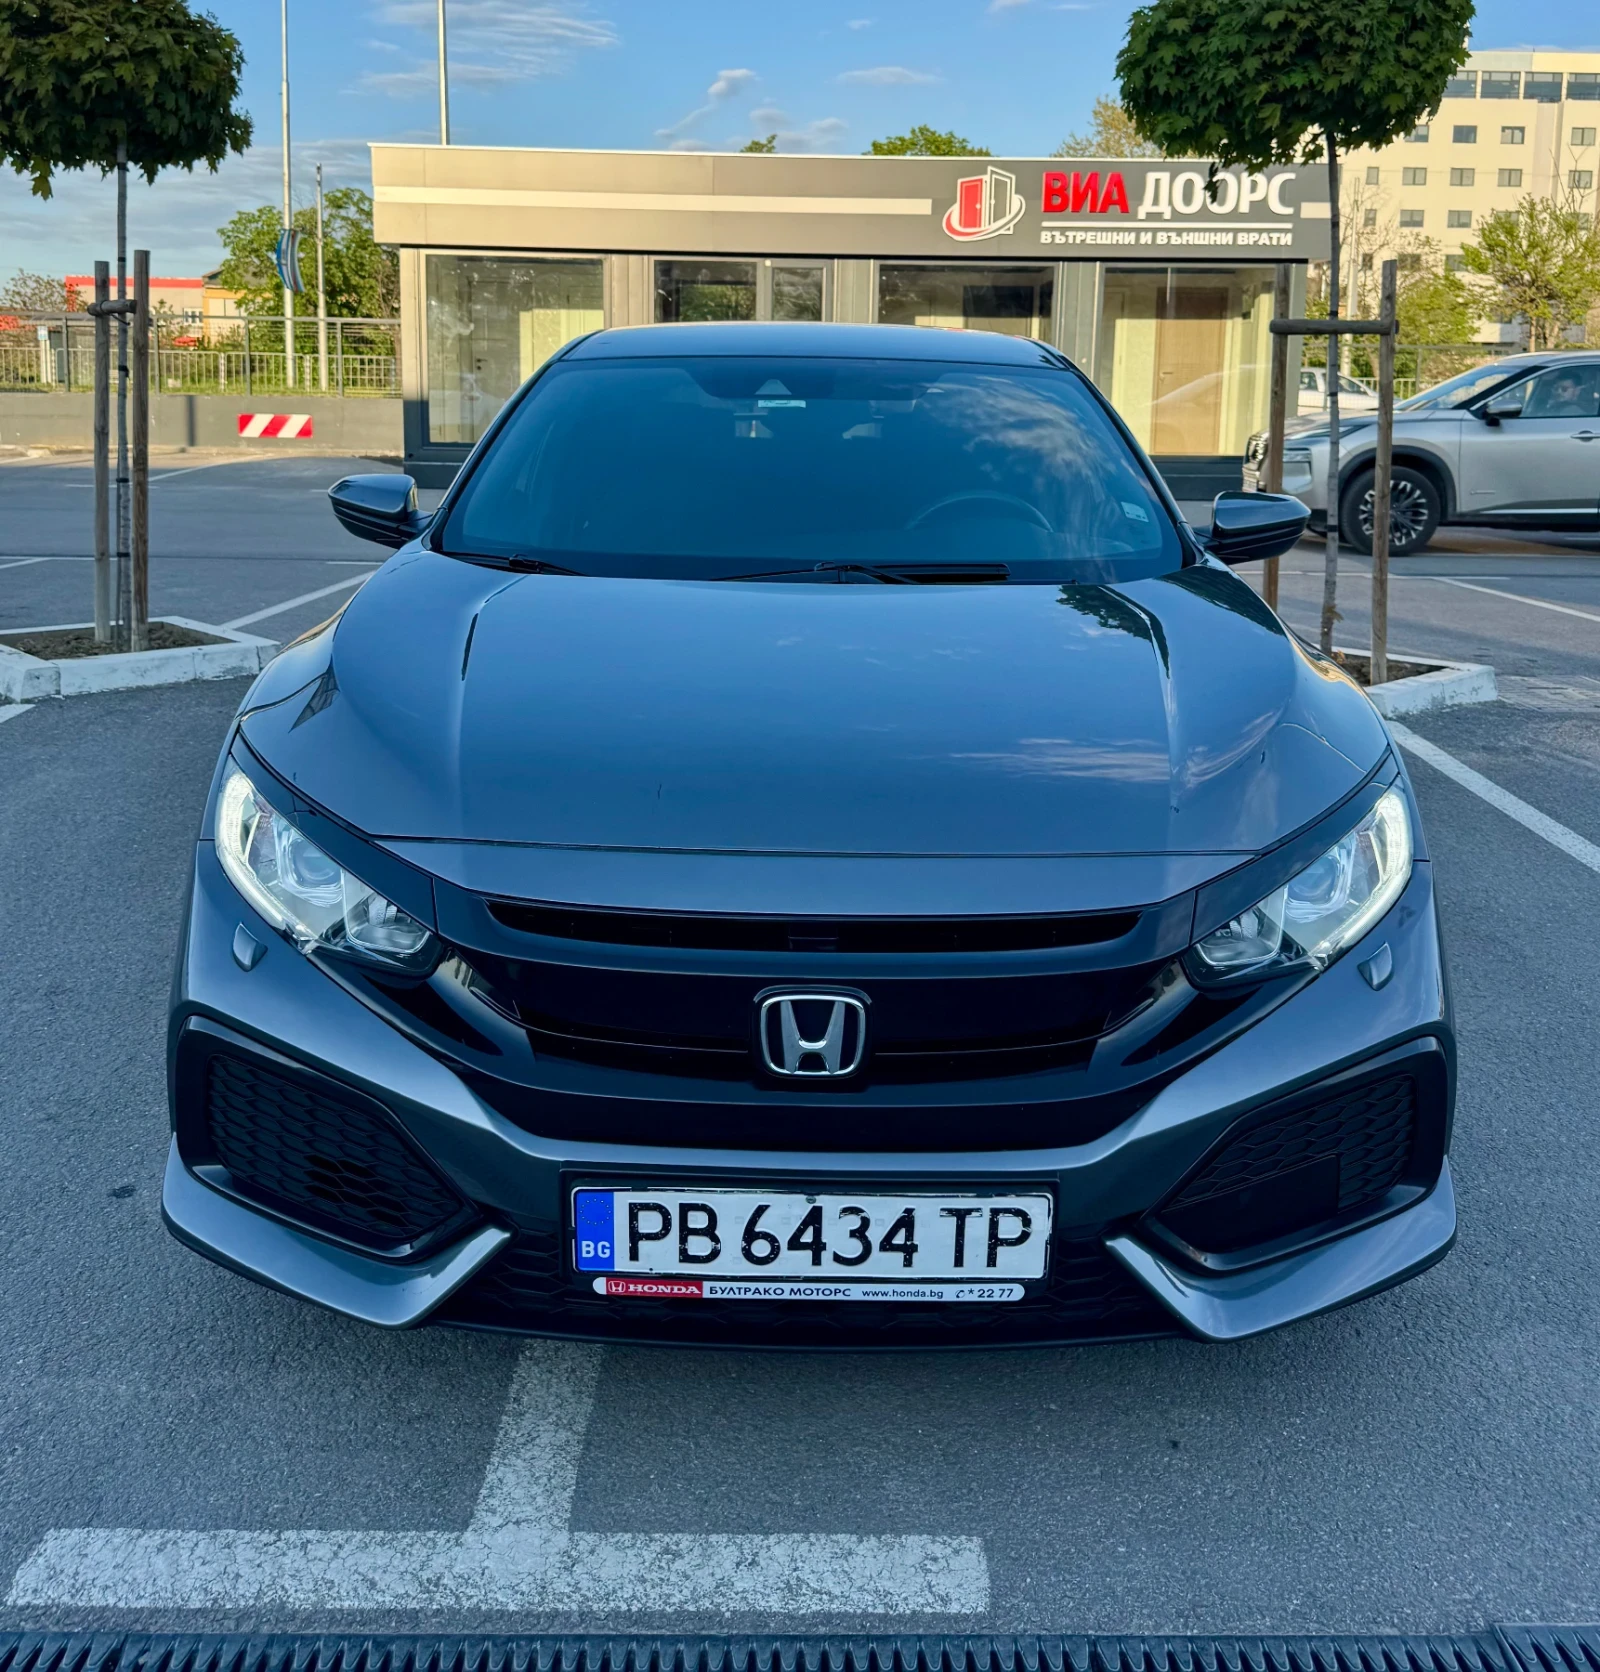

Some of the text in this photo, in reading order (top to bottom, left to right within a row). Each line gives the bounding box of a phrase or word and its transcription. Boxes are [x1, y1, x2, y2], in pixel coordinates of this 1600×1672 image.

[1042, 171, 1297, 220] ВИА ДООРС
[1040, 231, 1293, 246] ВЪТРЕШНИ И ВЪНШНИ ВРАТИ
[628, 1202, 722, 1263] PB
[741, 1204, 919, 1267] 6434
[581, 1240, 611, 1258] BG
[628, 1283, 701, 1294] HONDA
[709, 1286, 851, 1297] БУЛТРАКО МОТОРС
[862, 1288, 945, 1299] www.honda.bg
